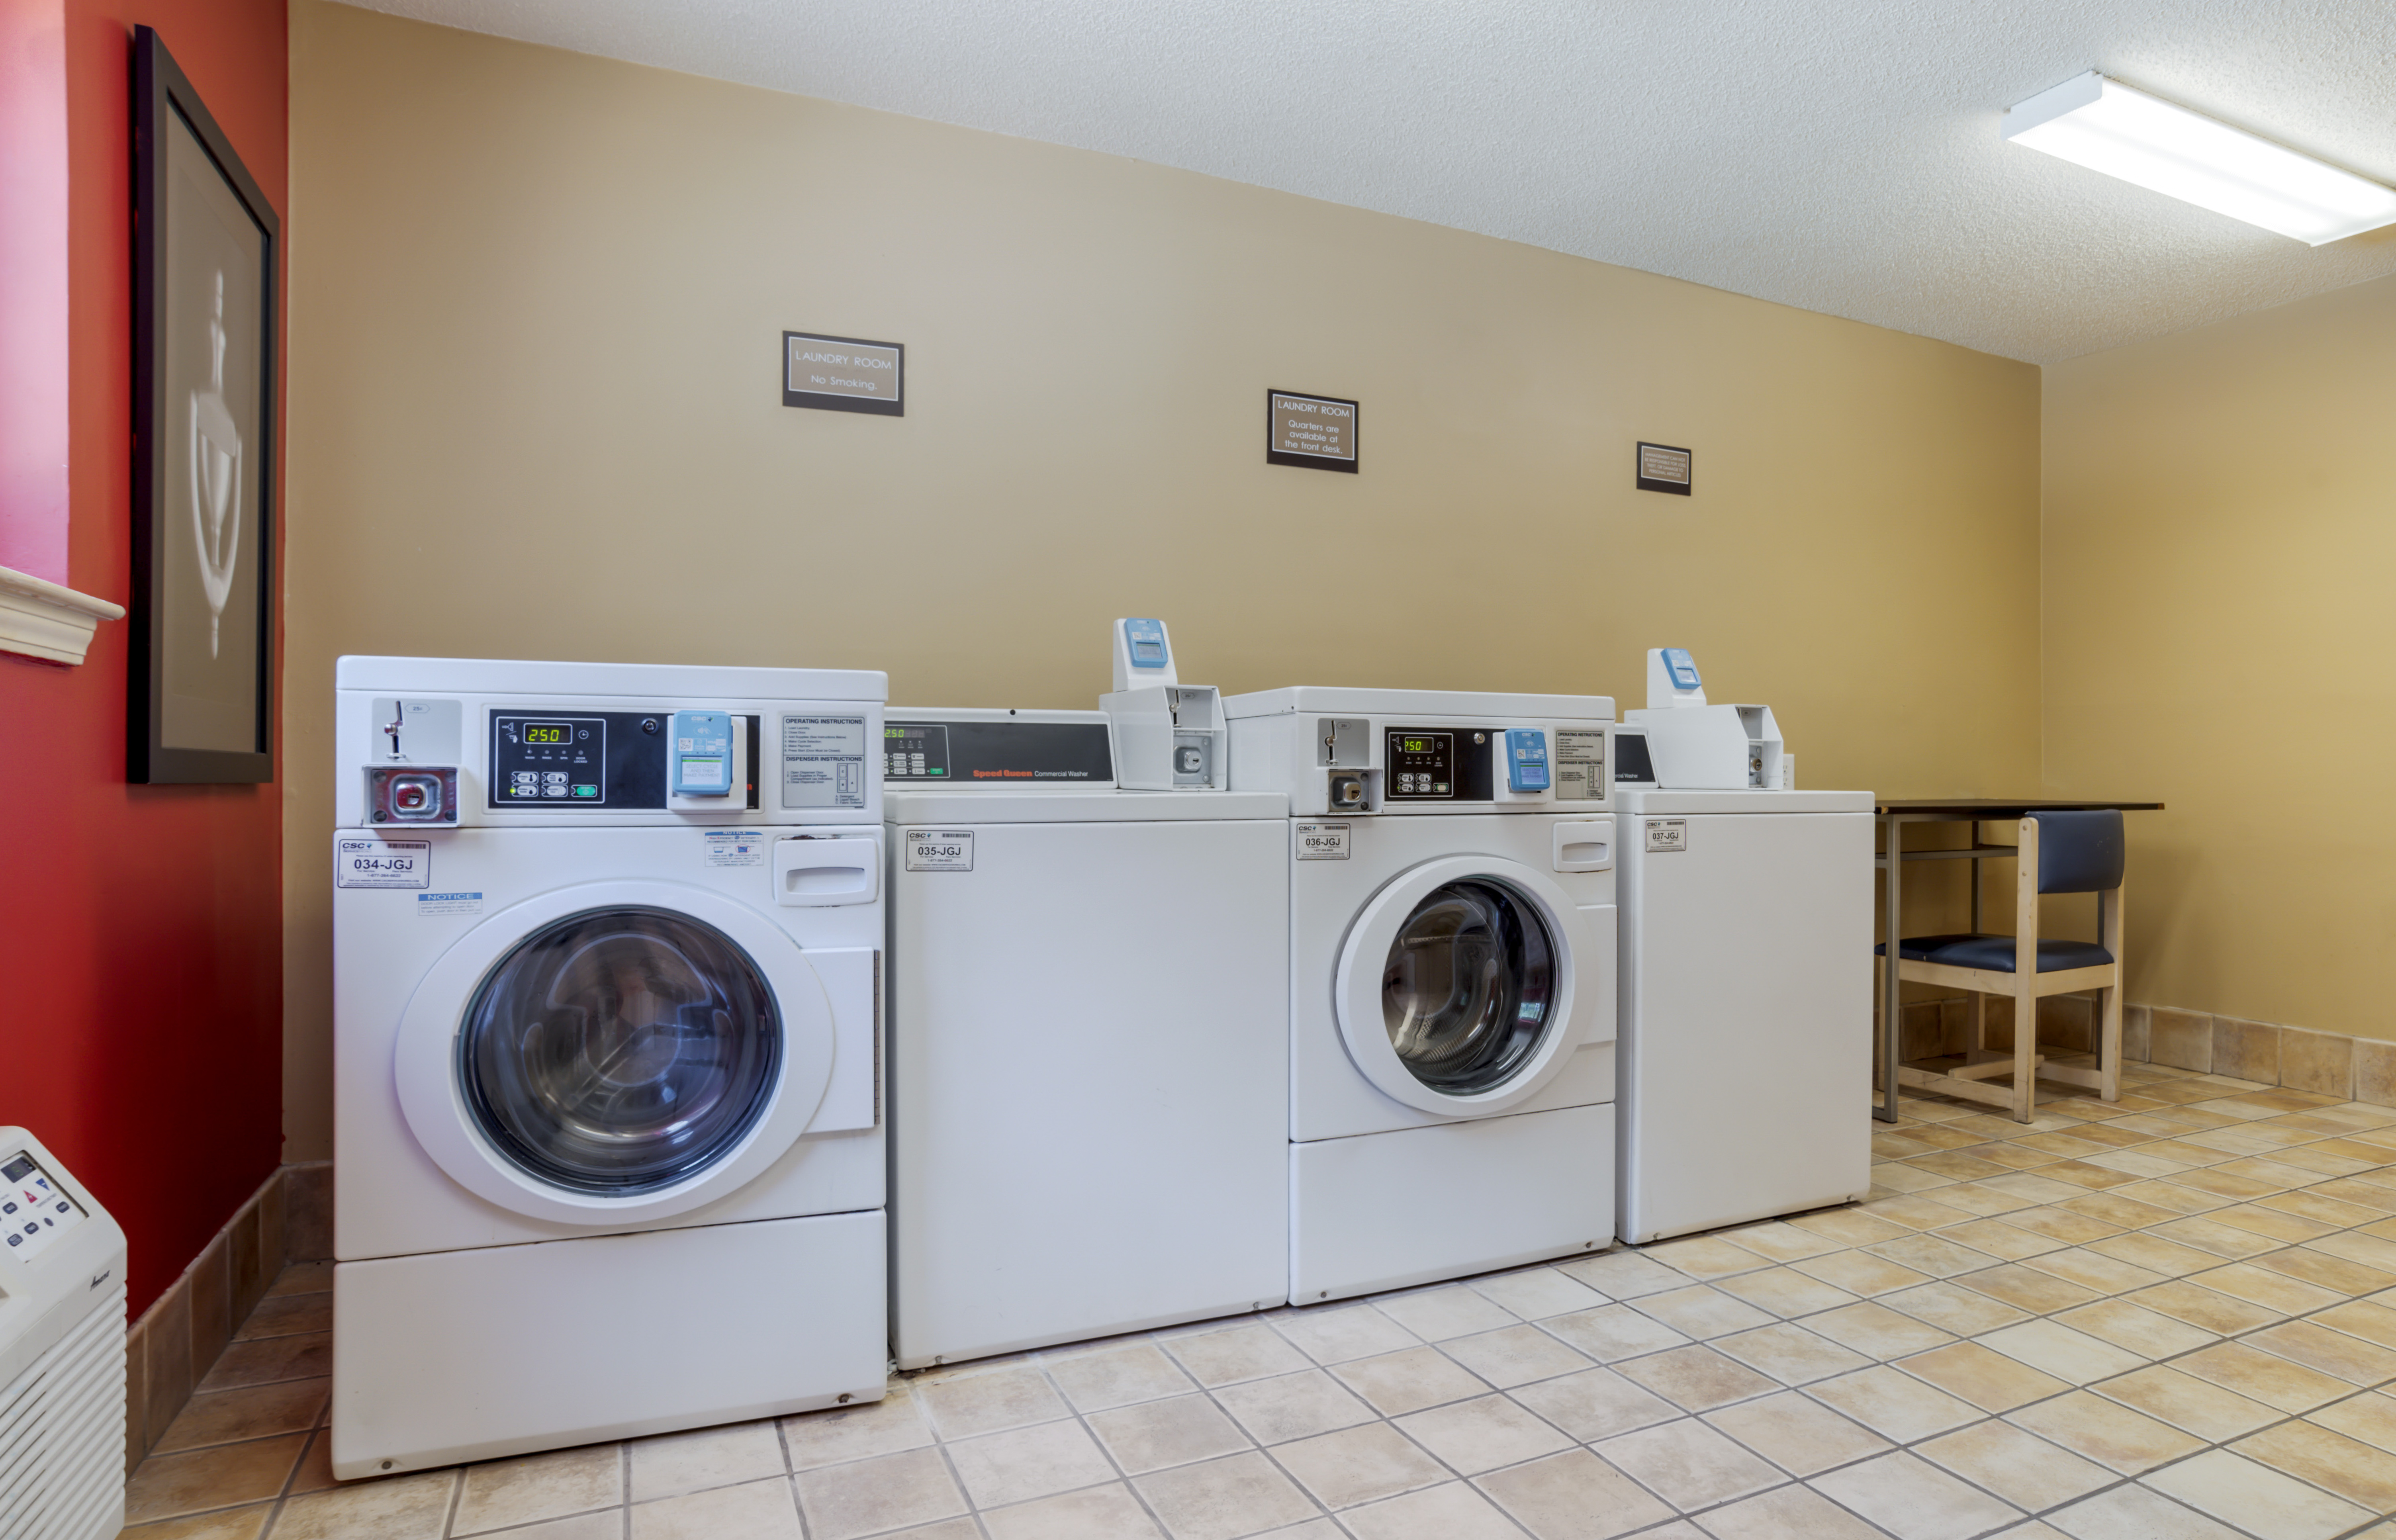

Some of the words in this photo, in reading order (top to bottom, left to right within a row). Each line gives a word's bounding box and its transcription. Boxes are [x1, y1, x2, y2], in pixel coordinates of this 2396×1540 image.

[796, 350, 848, 365] LAUNDRY
[855, 357, 892, 370] ROOM
[811, 375, 826, 384] No
[830, 377, 877, 391] Smoking.
[1278, 400, 1317, 413] LAUNDRY
[1321, 406, 1349, 417] ROOM
[1288, 420, 1323, 431] Quarters
[1290, 431, 1326, 442] available
[1302, 442, 1319, 451] front
[1323, 445, 1343, 454] desk.
[973, 769, 1002, 779] Speed
[918, 847, 961, 855] 035-JGJ
[354, 859, 413, 870] 034-JGJ
